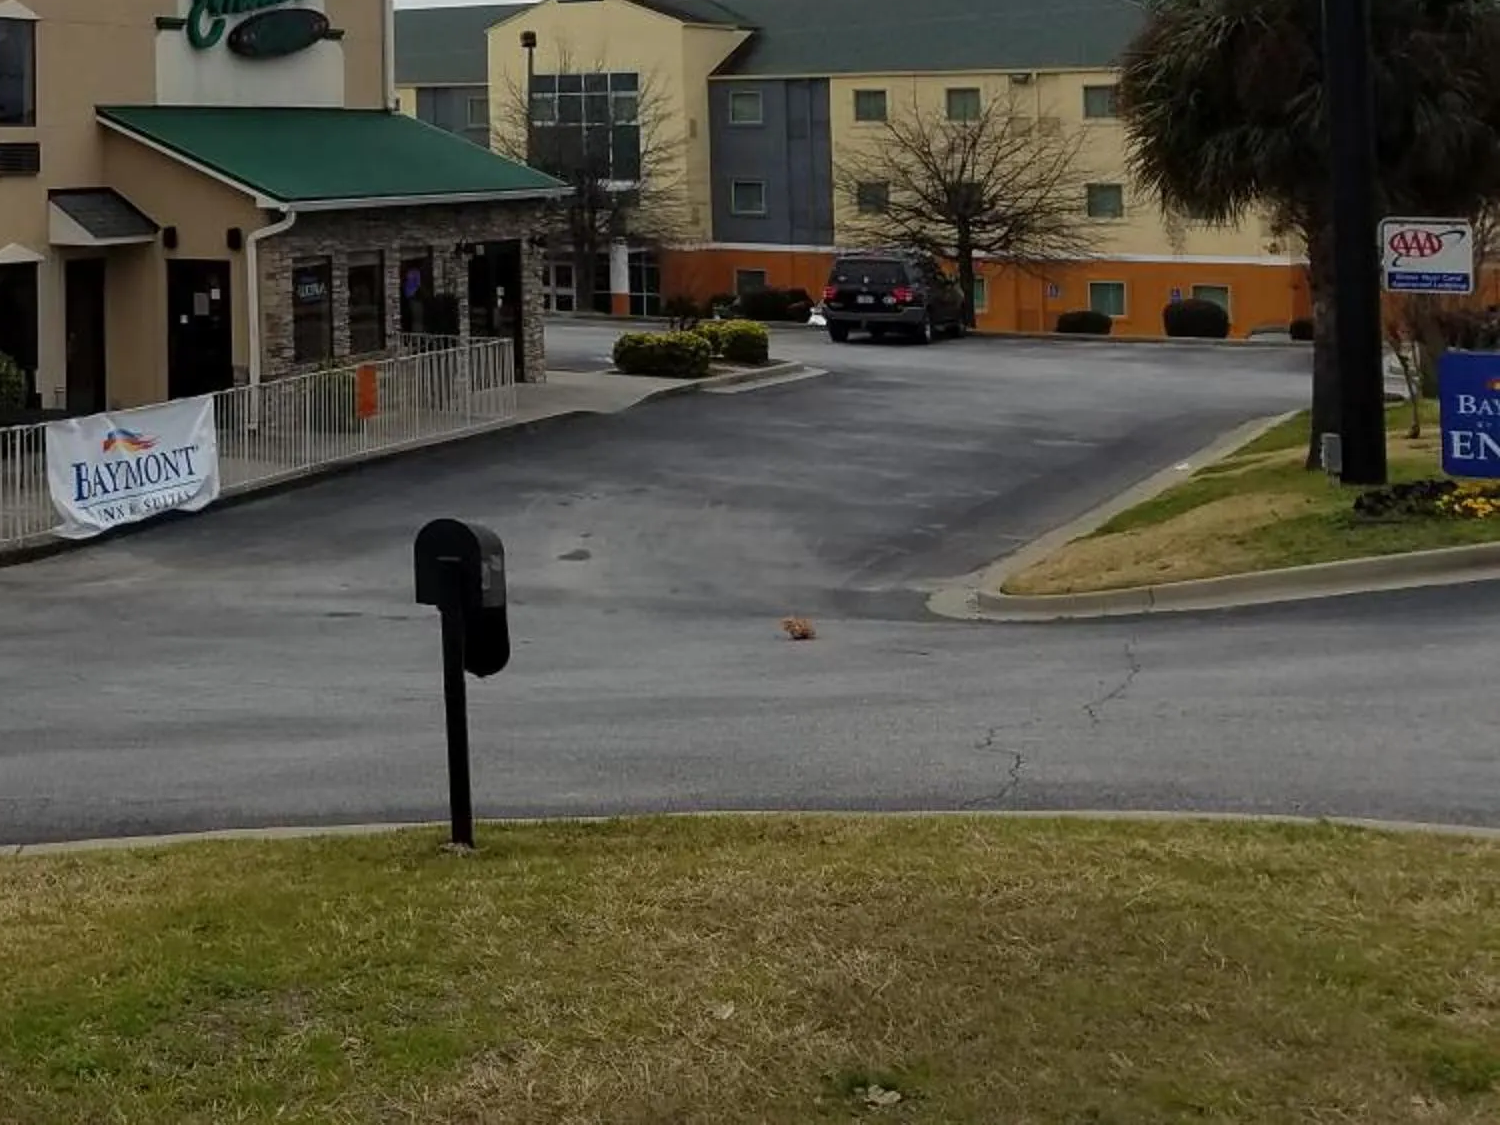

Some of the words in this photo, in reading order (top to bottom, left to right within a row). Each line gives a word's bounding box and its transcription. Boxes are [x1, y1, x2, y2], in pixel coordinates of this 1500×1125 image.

[1391, 230, 1439, 257] AAA
[1448, 430, 1500, 459] EN
[72, 446, 196, 501] BAYMONT
